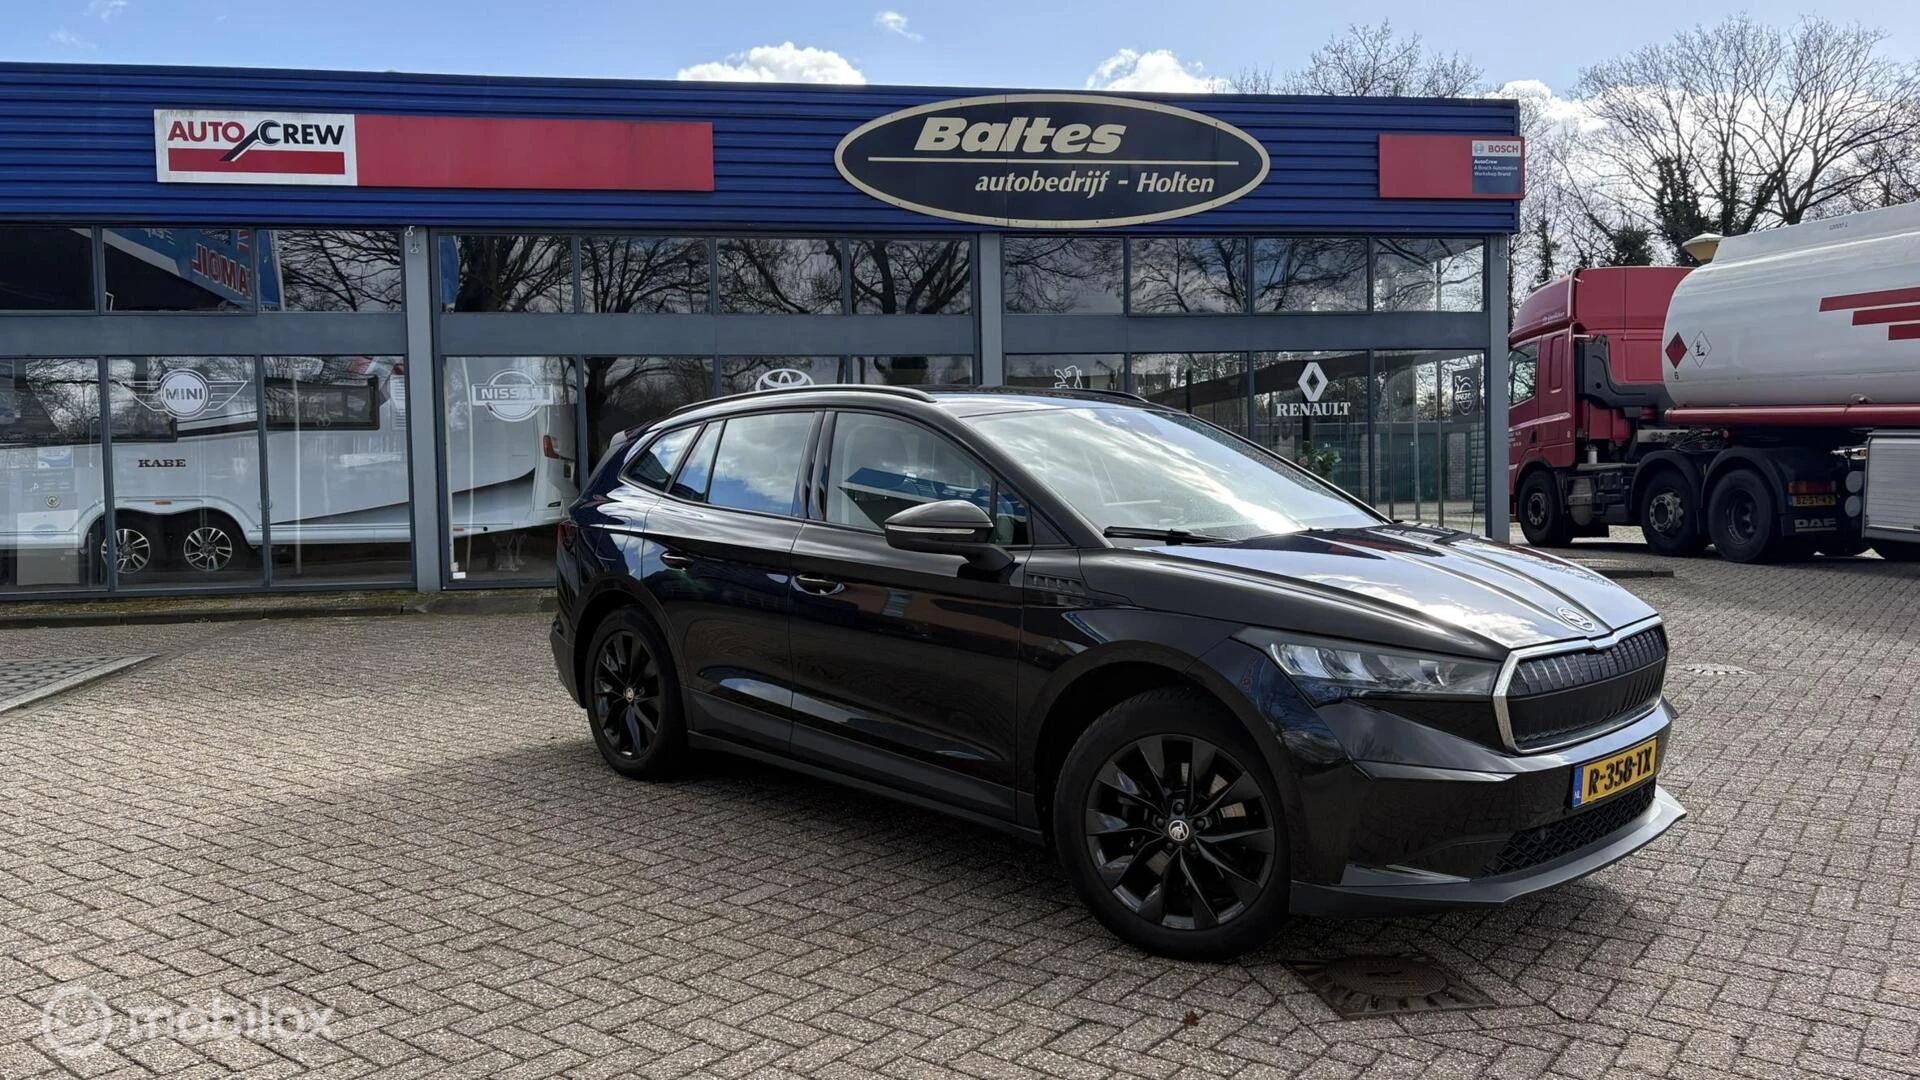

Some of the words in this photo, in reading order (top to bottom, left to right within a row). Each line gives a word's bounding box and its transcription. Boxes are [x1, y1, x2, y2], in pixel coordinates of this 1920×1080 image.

[168, 121, 245, 143] AUTO
[260, 120, 345, 146] CREW
[914, 117, 1127, 154] Baltes
[1488, 145, 1519, 153] BOSCH
[975, 169, 1110, 199] autobedrijf
[1136, 171, 1216, 193] Holten
[165, 388, 203, 400] MINI
[481, 388, 544, 400] NISSAN
[1276, 402, 1351, 417] RENAULT
[138, 458, 187, 468] KABE
[1794, 519, 1837, 528] DAF
[1588, 746, 1652, 797] R-358-TX
